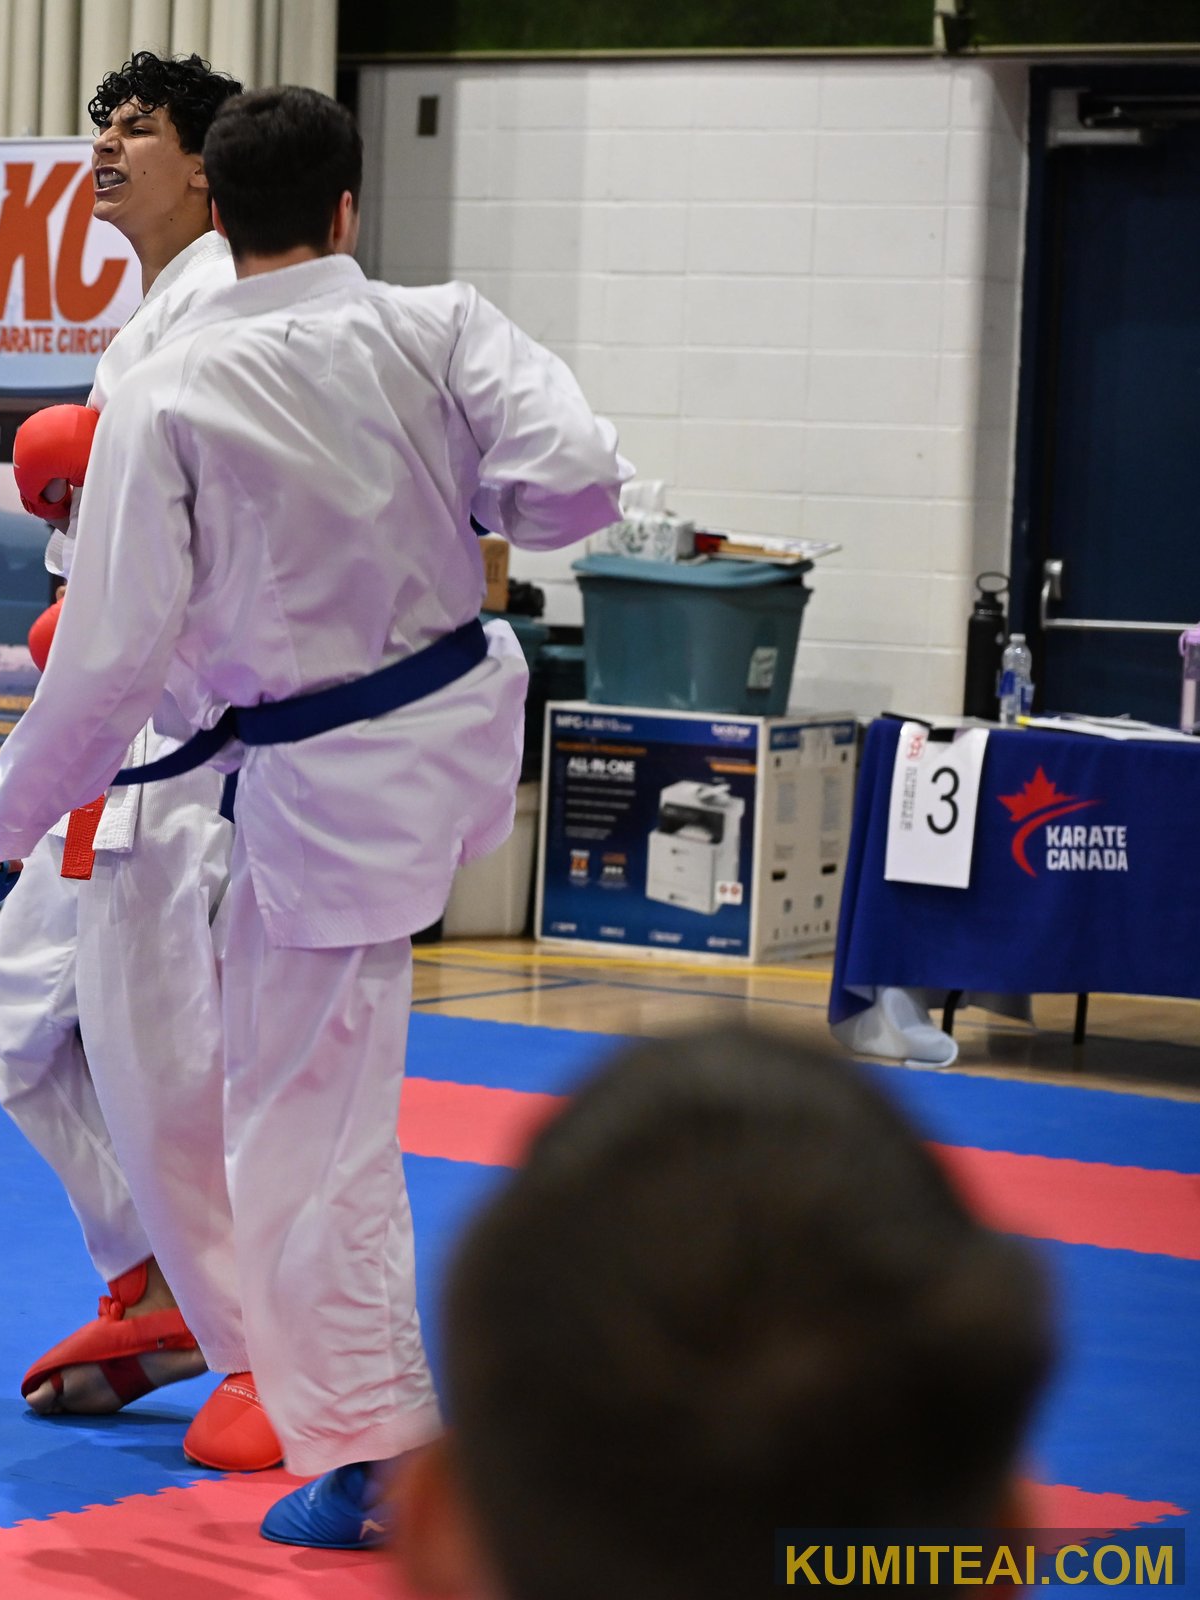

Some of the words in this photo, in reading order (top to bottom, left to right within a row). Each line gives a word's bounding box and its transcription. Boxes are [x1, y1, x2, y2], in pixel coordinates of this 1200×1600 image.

[57, 327, 120, 354] CIRCU
[926, 766, 960, 835] 3
[1046, 825, 1128, 849] KARATE
[1046, 848, 1129, 872] CANADA
